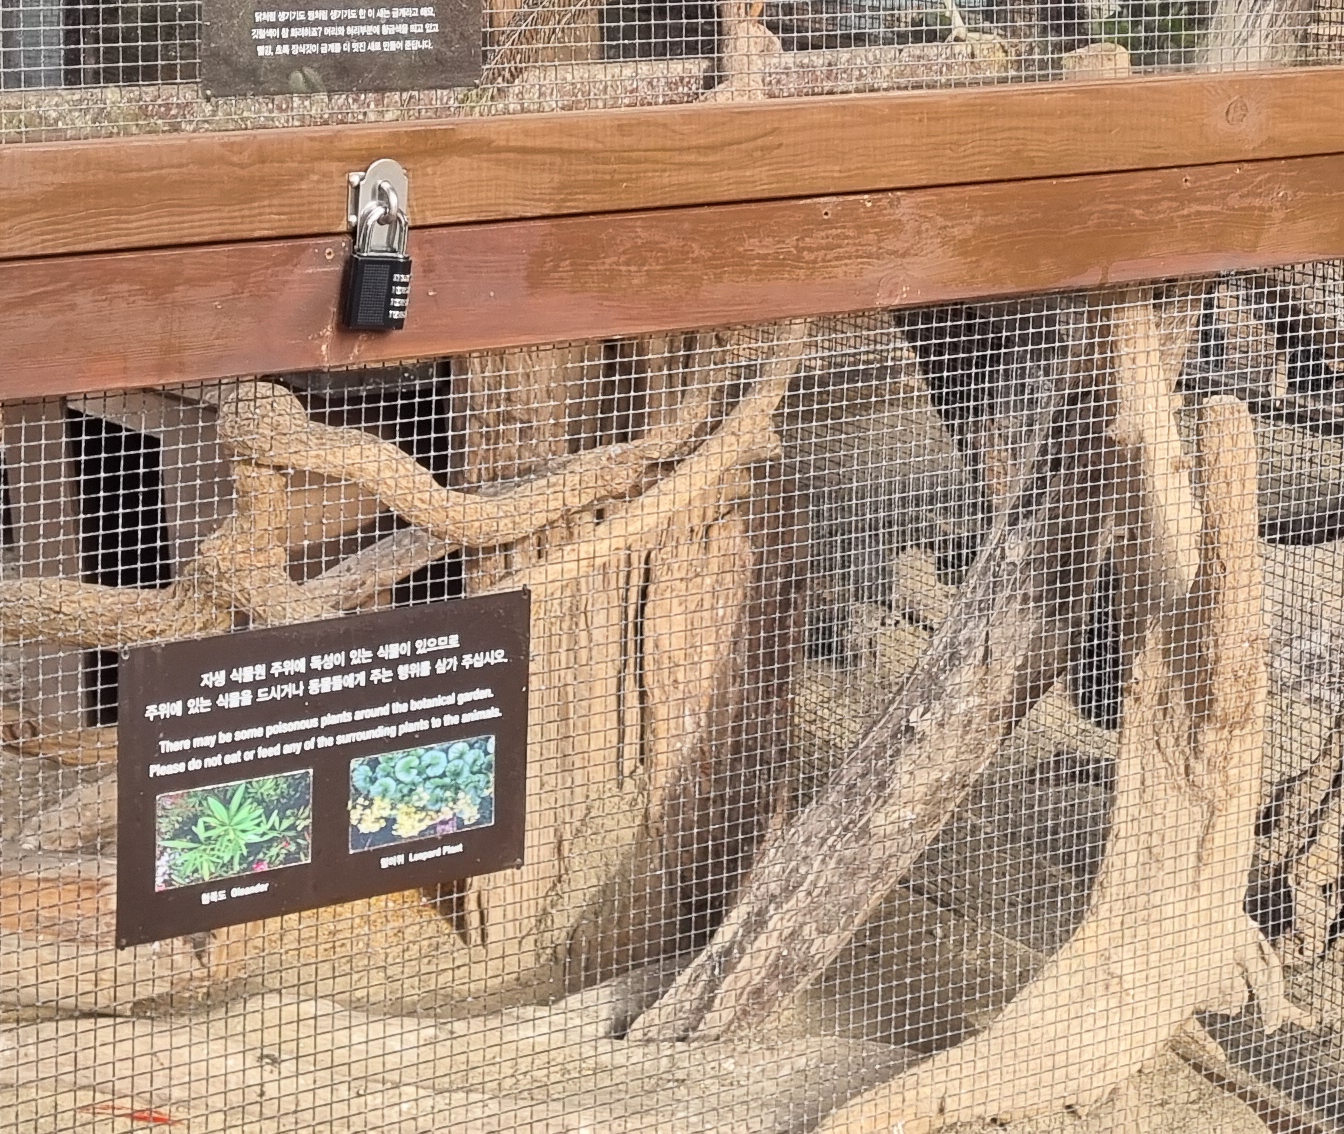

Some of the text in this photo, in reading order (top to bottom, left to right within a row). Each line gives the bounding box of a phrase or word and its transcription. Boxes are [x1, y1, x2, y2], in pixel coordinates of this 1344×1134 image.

[278, 11, 306, 21] 생기기도
[330, 9, 357, 20] 생기기도
[359, 9, 366, 19] 한
[368, 8, 375, 19] 이
[376, 8, 390, 19] 새는
[392, 8, 418, 18] 금계라고
[252, 28, 279, 39] 깃털색이
[324, 26, 345, 36] 머리와
[320, 43, 341, 53] 금계를
[200, 634, 460, 688] 자생 식물원 주위에 독성이 있는 식물이 있으므로
[145, 649, 508, 721] 주위에 있는 식물을 드시거나 동물들에게 주는 행위를 삼가 주십시오.
[159, 688, 494, 753] There may be some poisonous plants around the botanical garden.
[149, 706, 502, 777] Please do not eat or feed any of the surrounding plants to the animals.
[409, 847, 441, 862] Leopard
[442, 843, 463, 855] Plant
[231, 883, 269, 897] Oleander
